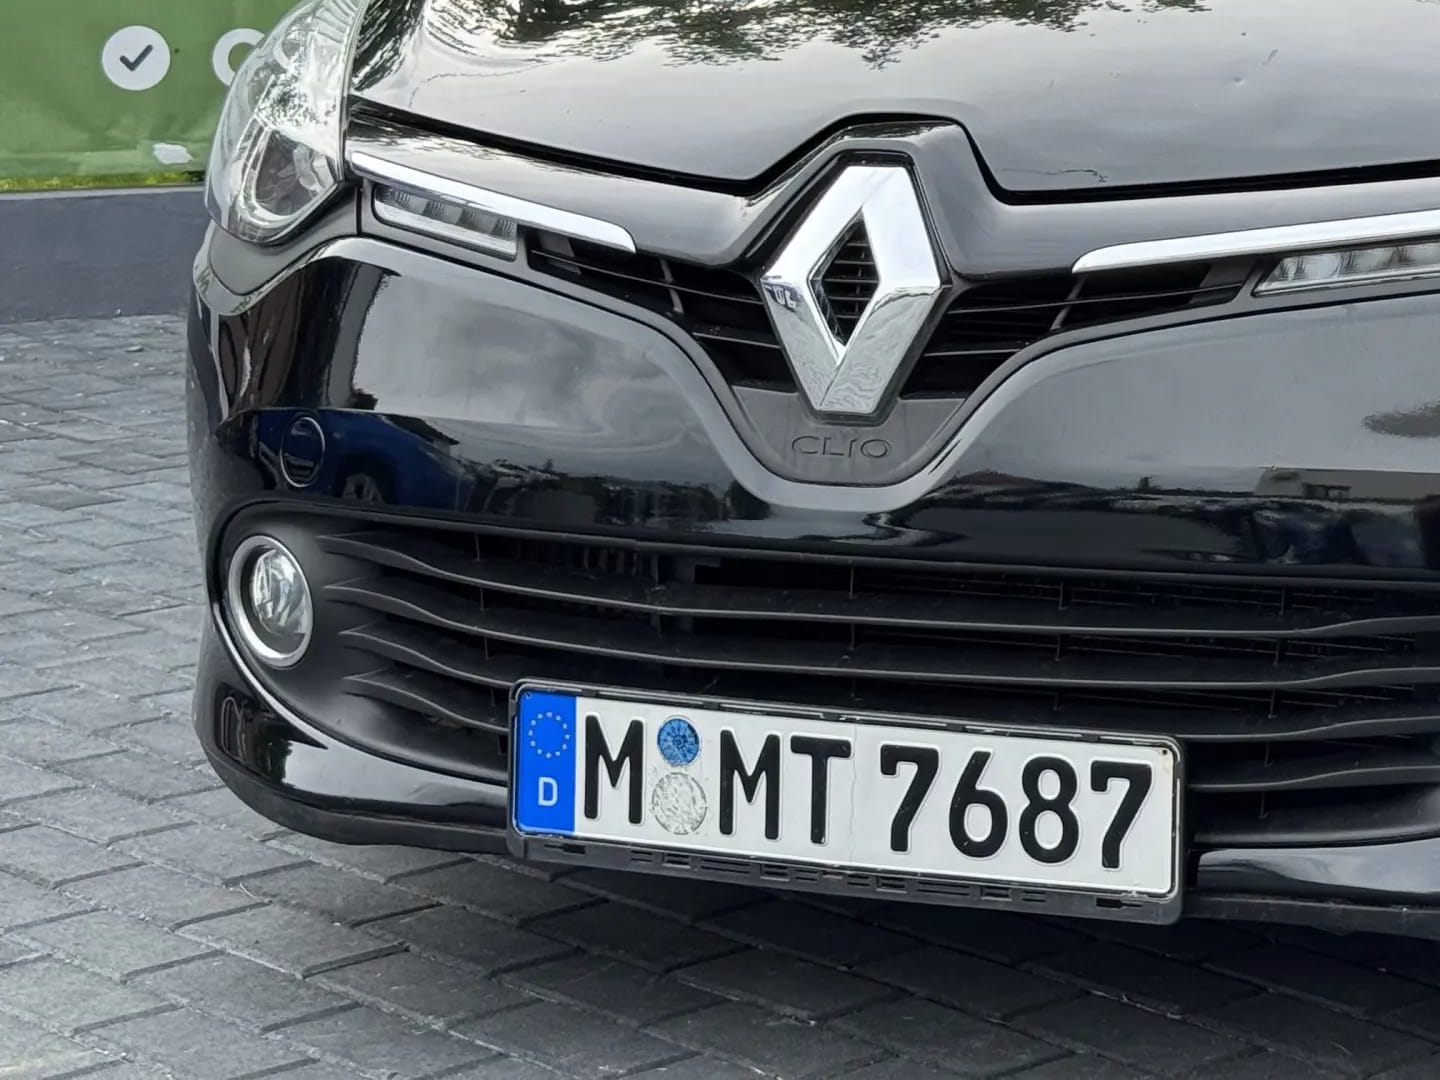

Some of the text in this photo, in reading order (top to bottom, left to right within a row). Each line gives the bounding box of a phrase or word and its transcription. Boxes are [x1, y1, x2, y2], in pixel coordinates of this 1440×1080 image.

[792, 435, 890, 458] CLIO
[538, 777, 558, 807] D
[584, 716, 1152, 868] M MT 7687
